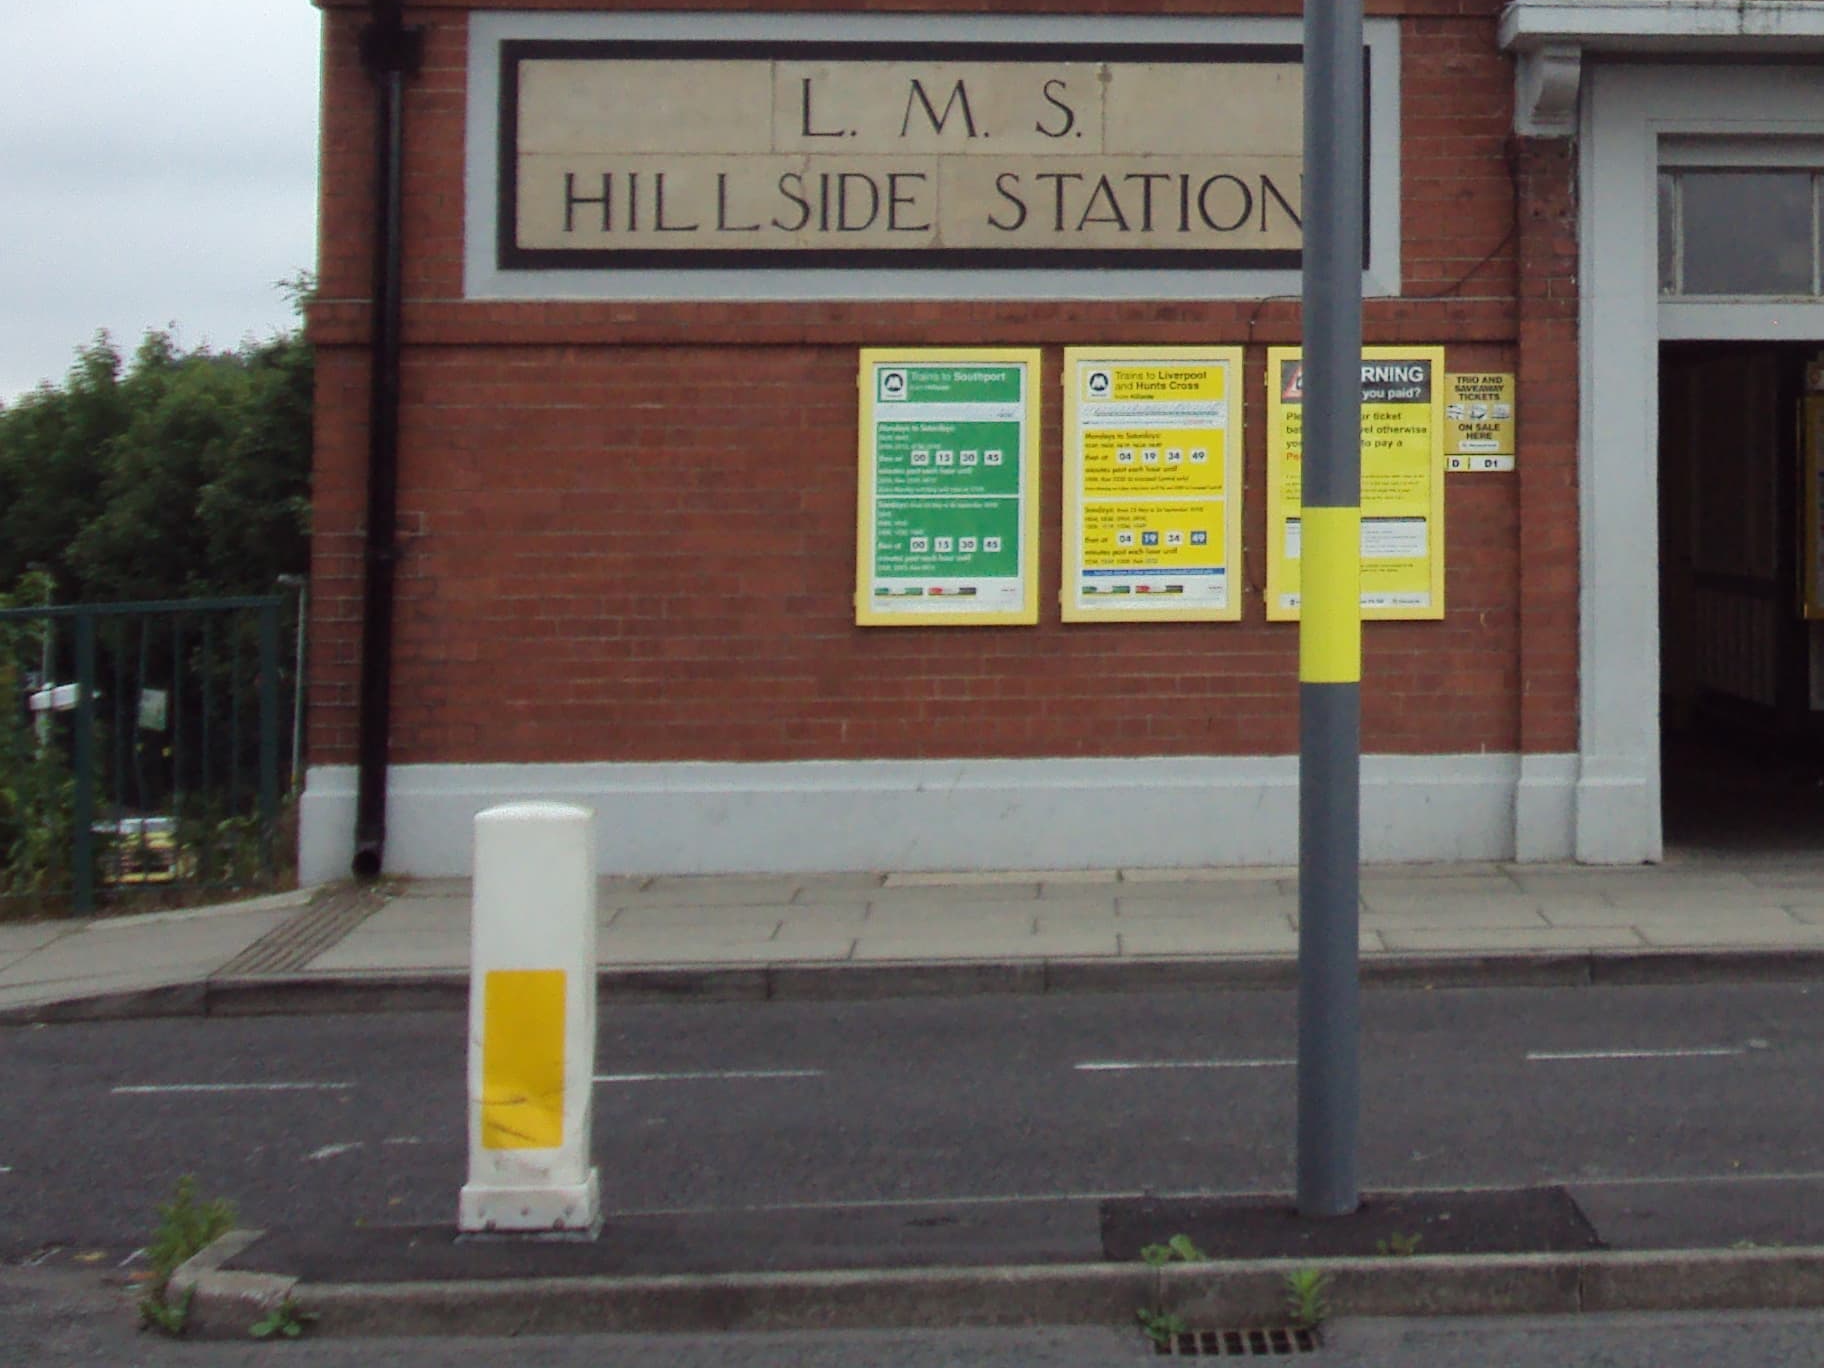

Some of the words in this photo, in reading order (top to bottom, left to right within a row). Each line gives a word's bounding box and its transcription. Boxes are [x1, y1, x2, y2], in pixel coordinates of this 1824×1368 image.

[562, 172, 933, 234] HILLSIDE
[986, 172, 1303, 234] STATION
[954, 371, 1006, 383] Southport
[1115, 371, 1143, 380] Trains
[1146, 371, 1156, 380] to
[1158, 371, 1207, 381] Liverpool
[1361, 366, 1424, 382] RNING
[1482, 376, 1503, 384] AND
[1115, 382, 1133, 390] and
[1136, 382, 1167, 390] Hunts
[1169, 381, 1200, 390] Cross
[1362, 389, 1385, 401] you
[1387, 387, 1421, 401] paid?
[1459, 393, 1500, 401] TICKETS
[1373, 412, 1401, 420] ticket
[1376, 425, 1427, 434] otherwise
[1458, 423, 1473, 431] ON
[1476, 423, 1500, 431] SALE
[1466, 432, 1493, 440] HERE
[1374, 441, 1393, 449] pay
[986, 454, 999, 462] 45
[1119, 452, 1132, 461] 04
[1144, 452, 1156, 460] 19
[1168, 452, 1181, 460] 34
[1192, 451, 1205, 460] 49
[1119, 534, 1132, 543] 04
[1168, 534, 1181, 543] 34
